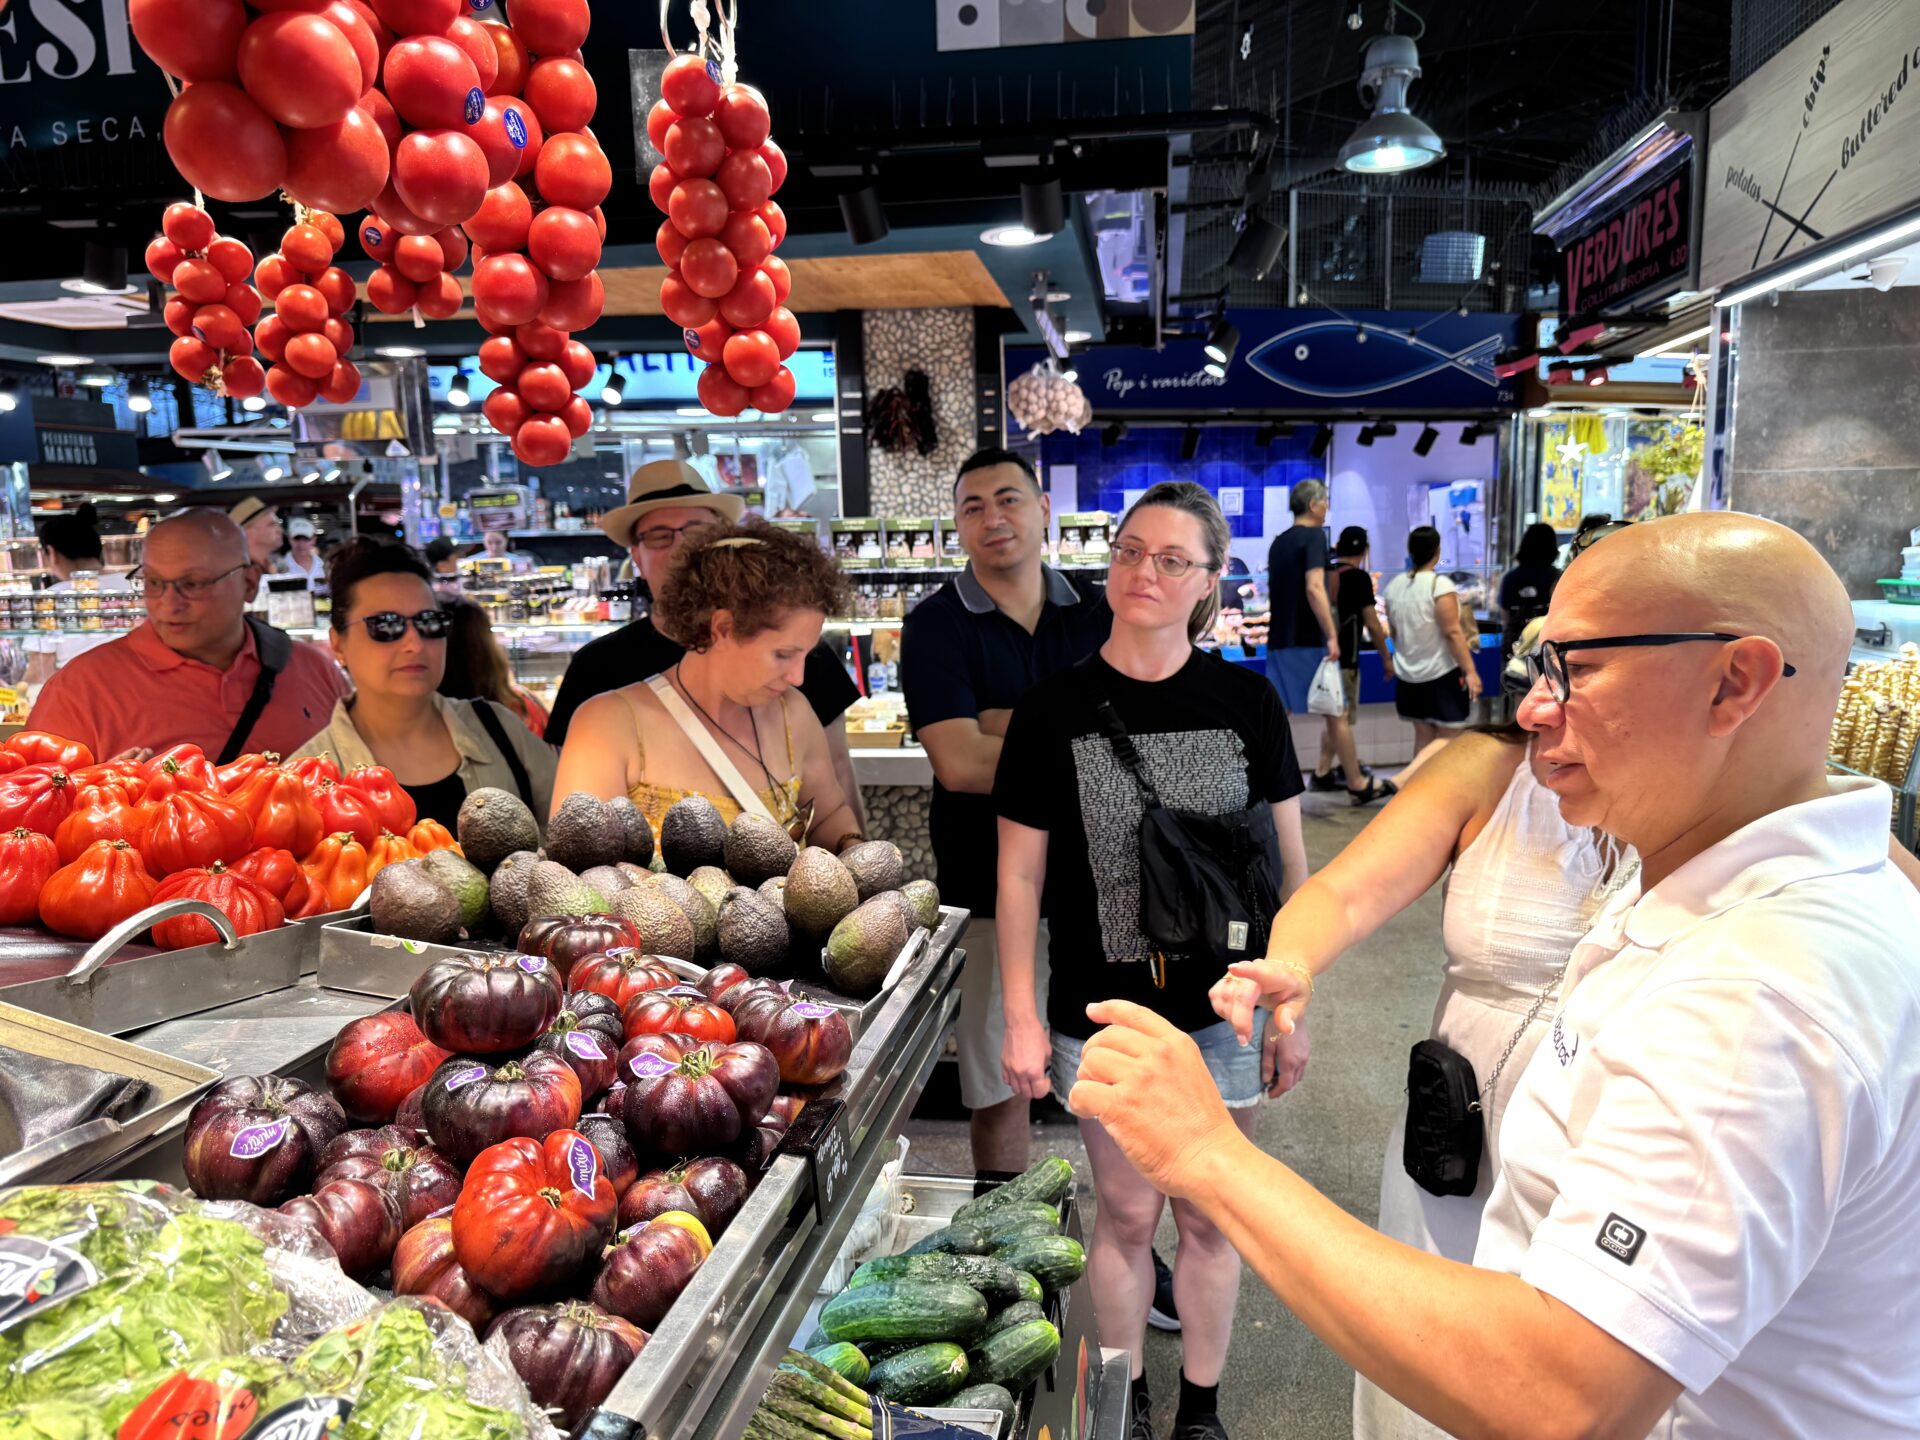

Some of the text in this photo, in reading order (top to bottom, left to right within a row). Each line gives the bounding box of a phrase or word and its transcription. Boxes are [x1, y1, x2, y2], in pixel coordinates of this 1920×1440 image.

[1567, 178, 1680, 316] VERDURES
[44, 445, 97, 466] MANOLO
[1601, 1237, 1628, 1257] OGIO
